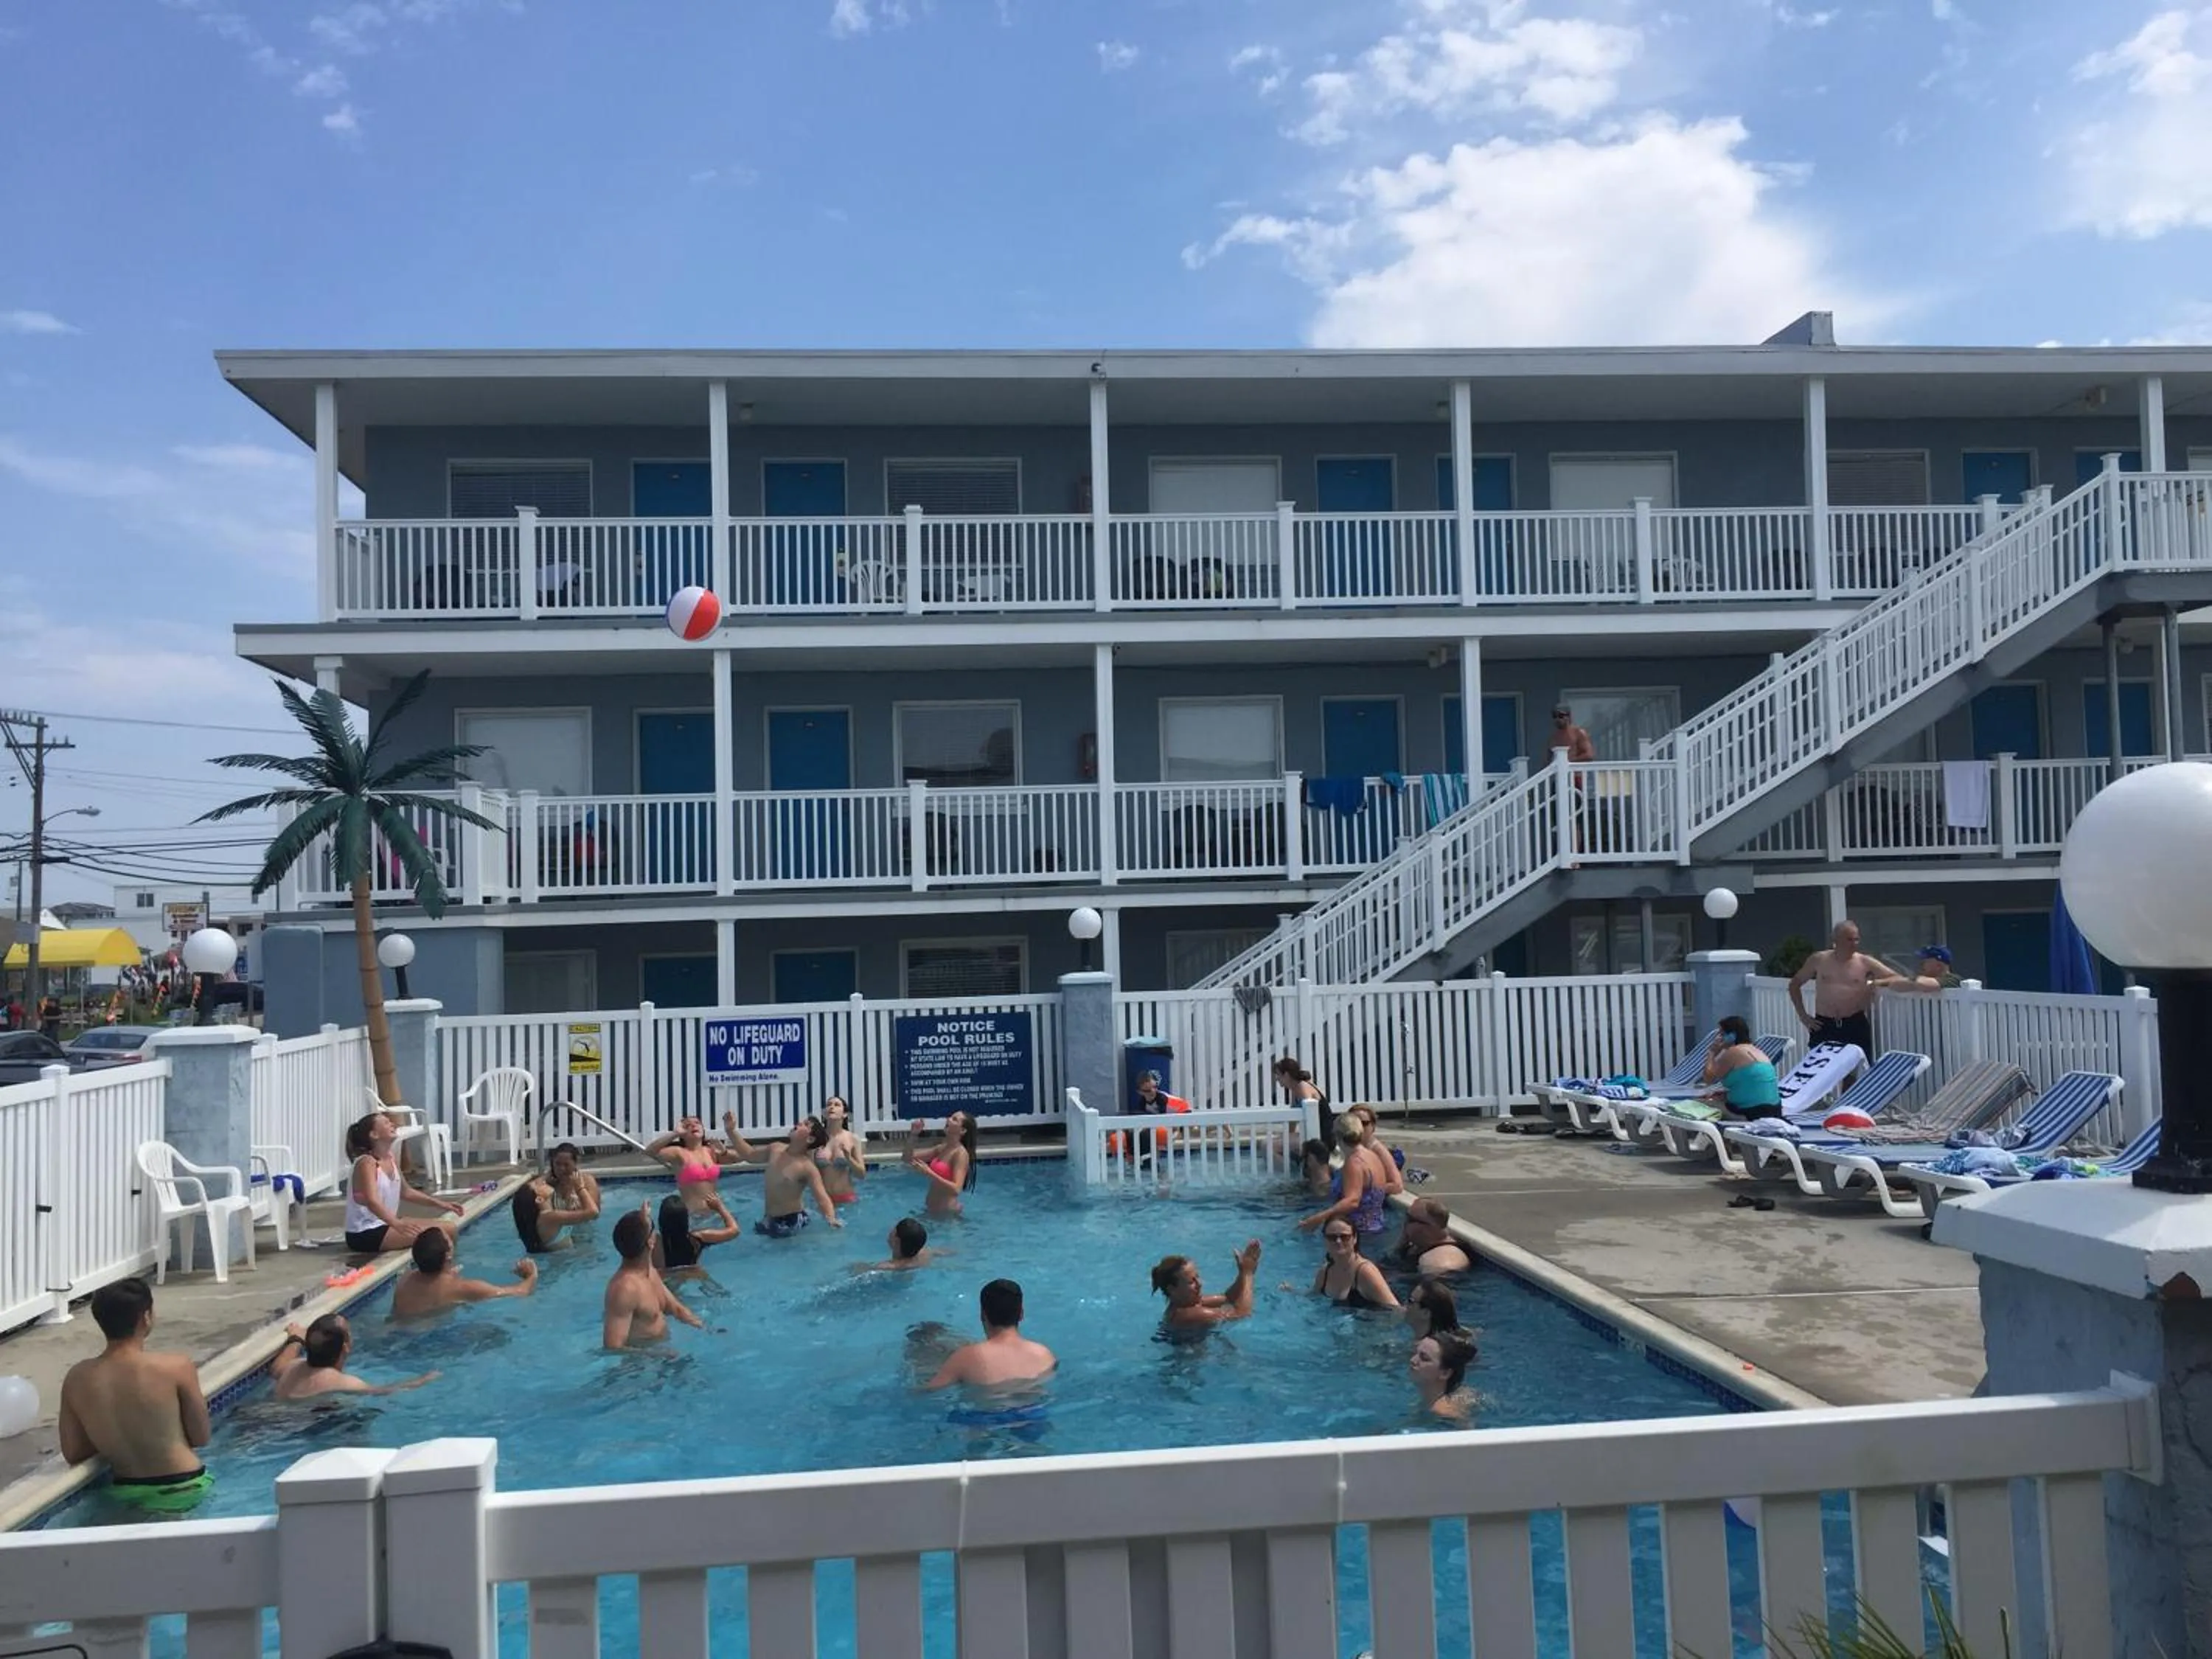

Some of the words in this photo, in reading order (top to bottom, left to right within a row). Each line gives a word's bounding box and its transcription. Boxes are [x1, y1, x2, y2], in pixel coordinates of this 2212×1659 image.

[709, 1026, 727, 1046] NO
[734, 1023, 800, 1044] LIFEGUARD
[937, 1020, 995, 1032] NOTICE
[918, 1034, 960, 1046] POOL
[964, 1032, 1015, 1045] RULES
[728, 1046, 745, 1065] ON
[751, 1045, 783, 1065] DUTY
